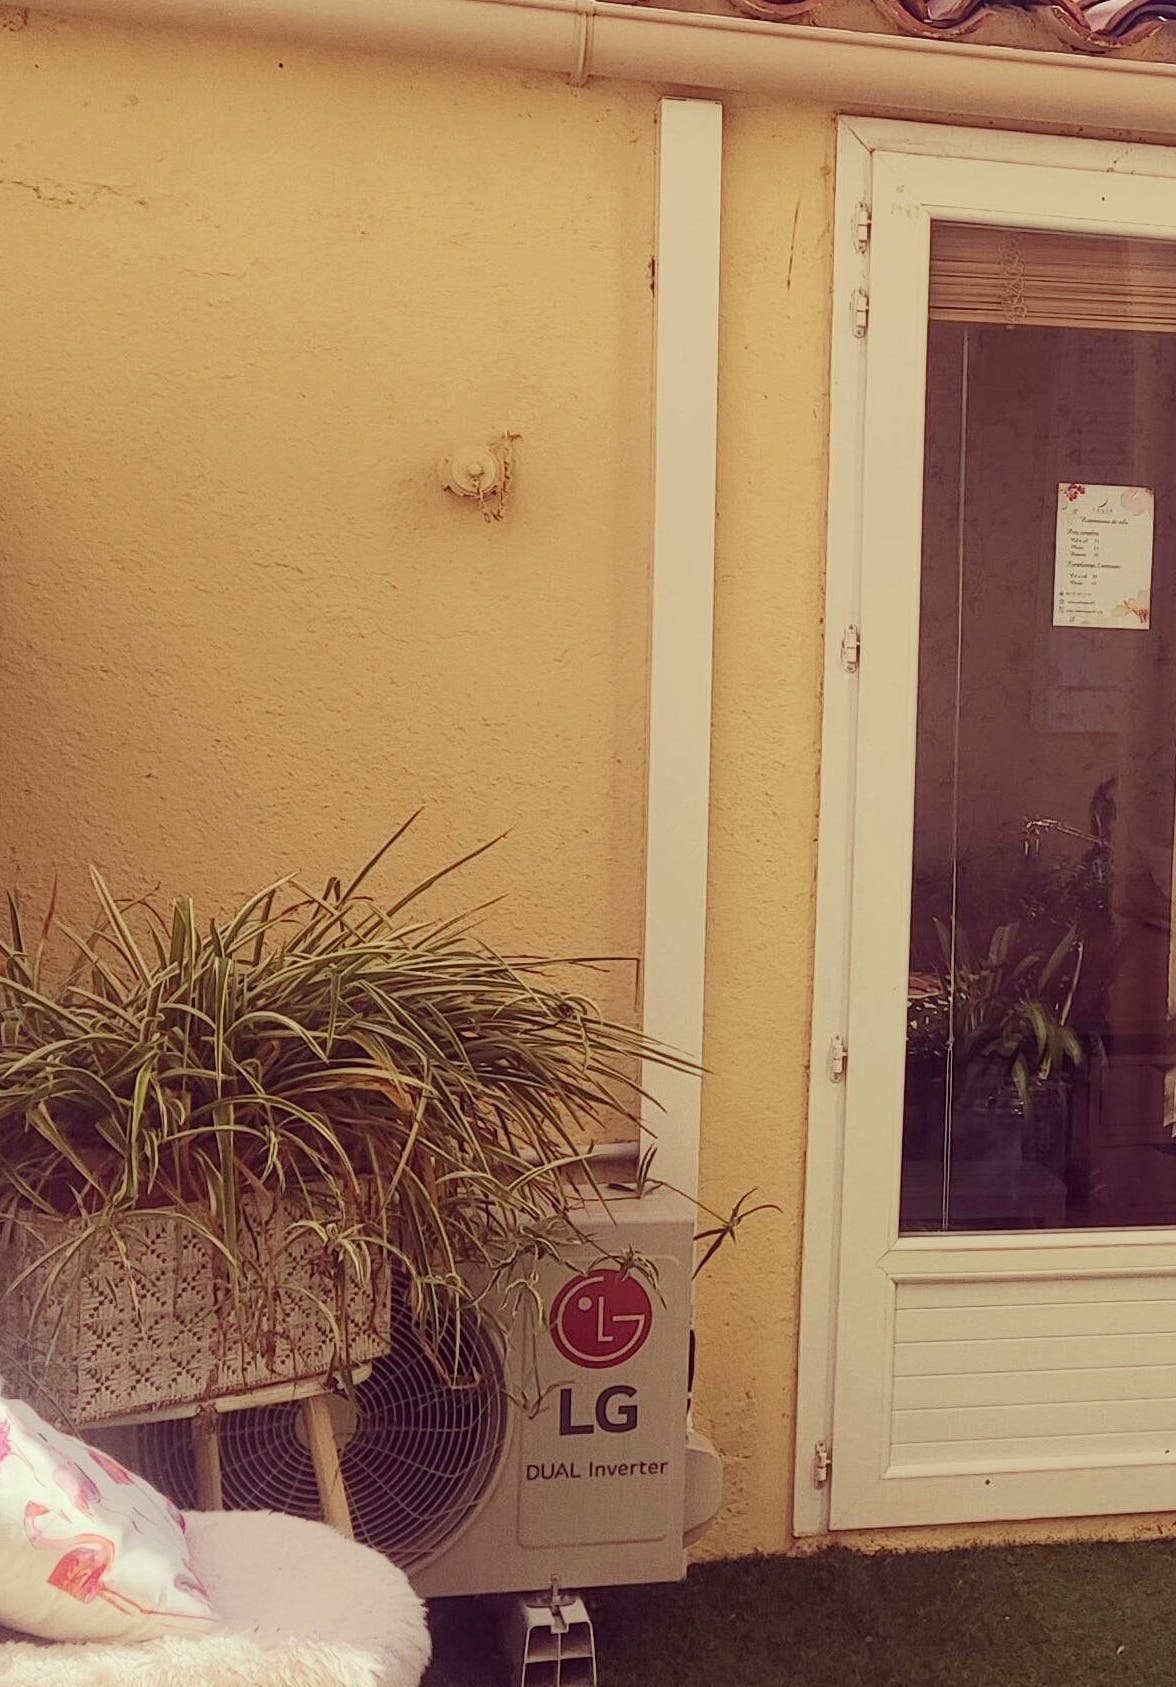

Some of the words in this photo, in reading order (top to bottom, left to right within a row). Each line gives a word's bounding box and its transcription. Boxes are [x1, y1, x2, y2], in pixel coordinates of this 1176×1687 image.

[557, 1276, 645, 1361] LG
[559, 1385, 638, 1436] LG
[526, 1462, 581, 1480] DUAL
[588, 1460, 668, 1477] Inverter
